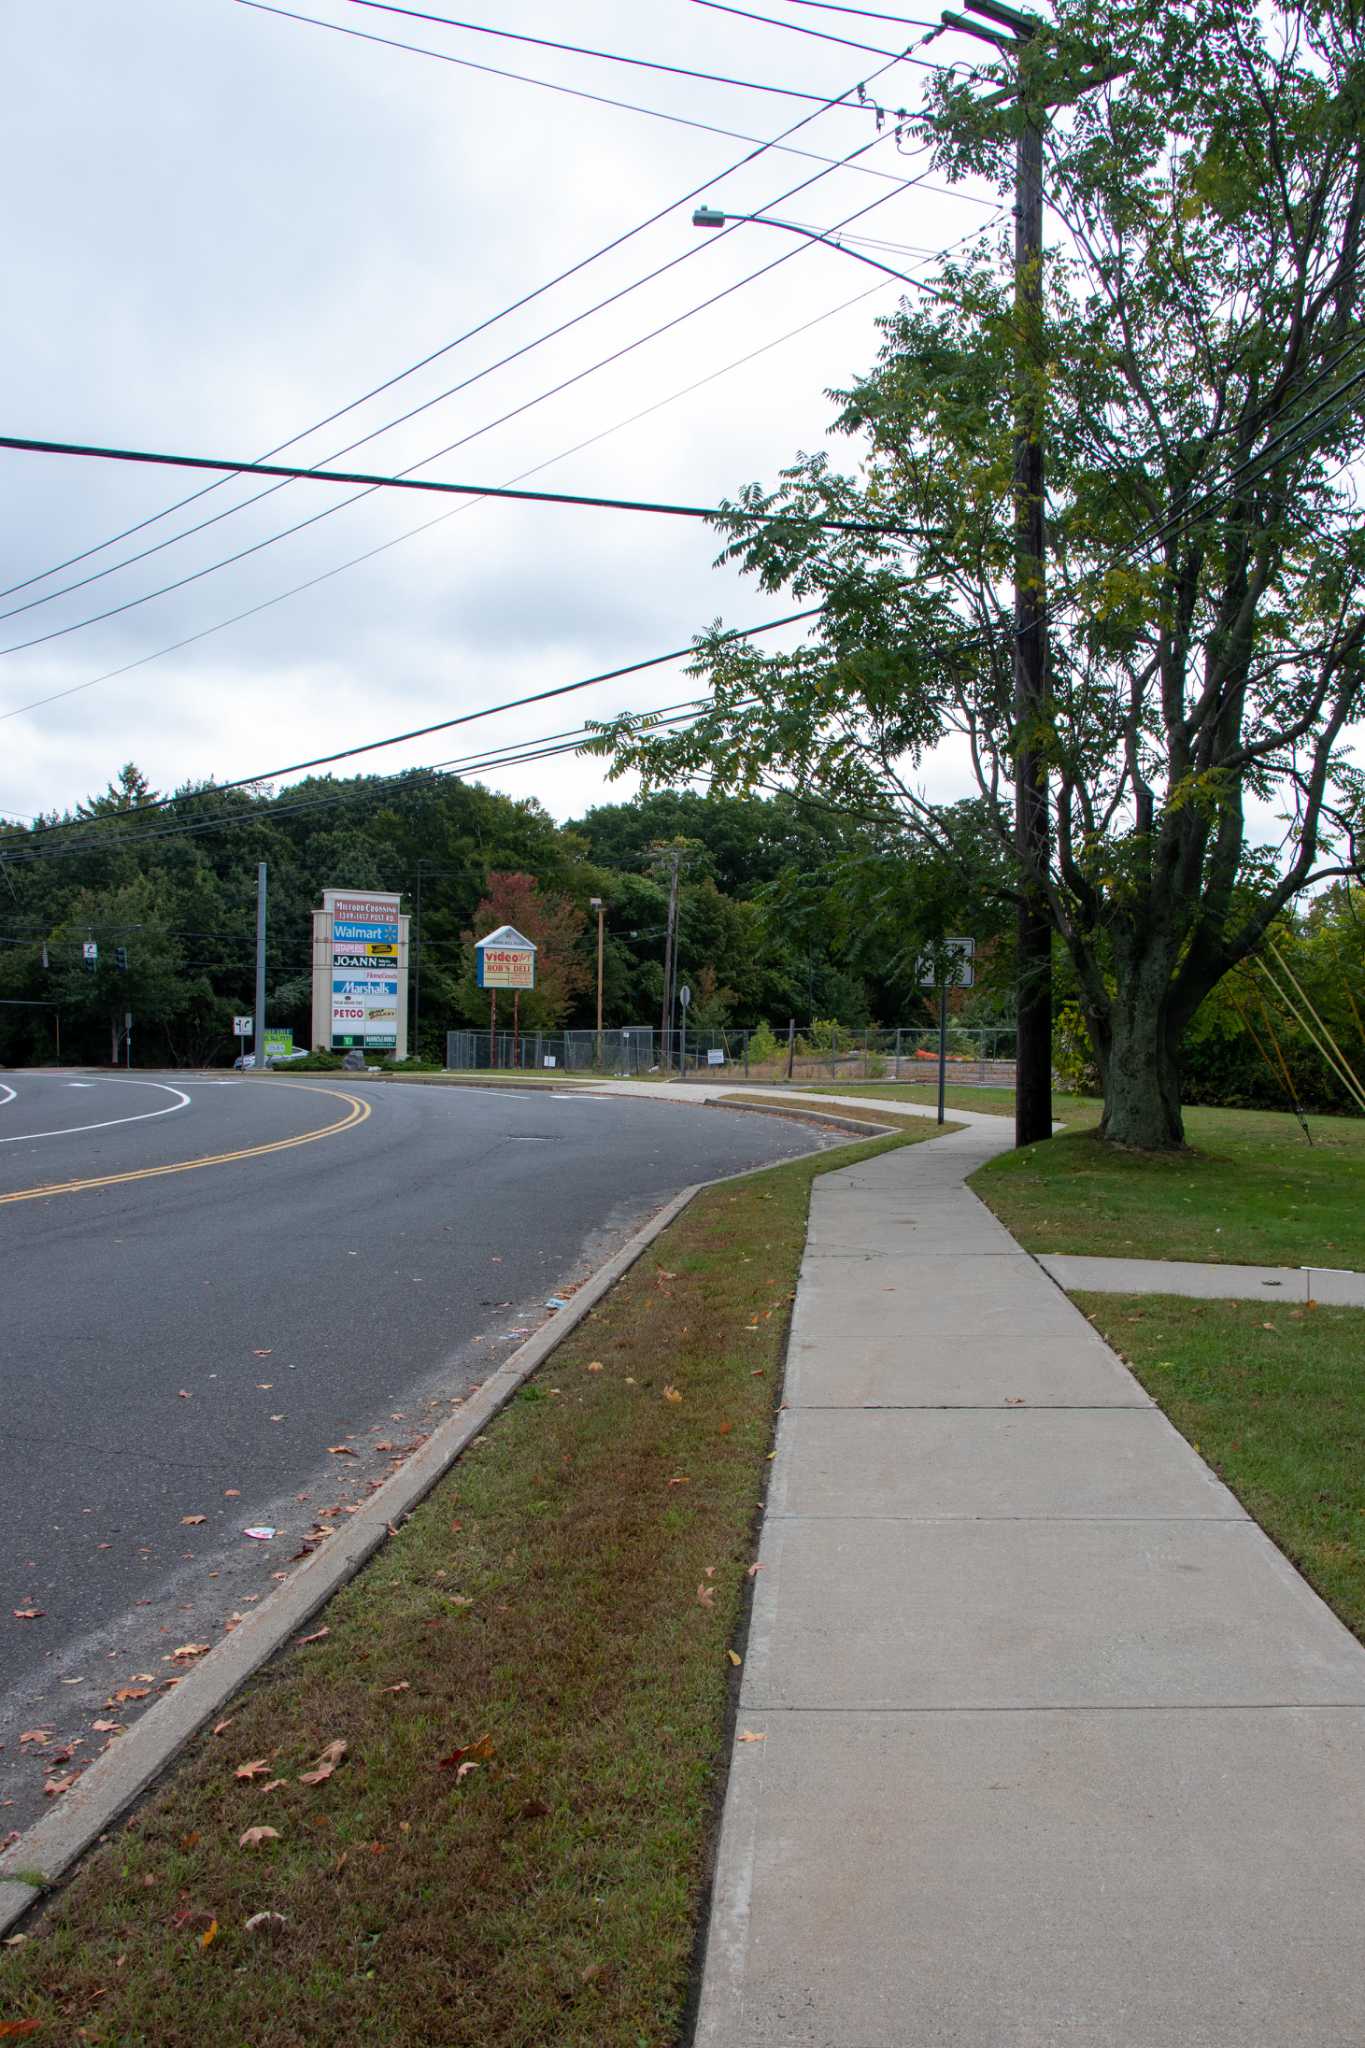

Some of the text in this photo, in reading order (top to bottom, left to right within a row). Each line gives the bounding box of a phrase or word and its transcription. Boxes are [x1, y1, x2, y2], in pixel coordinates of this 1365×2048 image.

[335, 926, 382, 939] Walmart
[486, 952, 518, 962] video
[341, 982, 390, 994] Marshalls
[333, 1009, 363, 1018] PETCO
